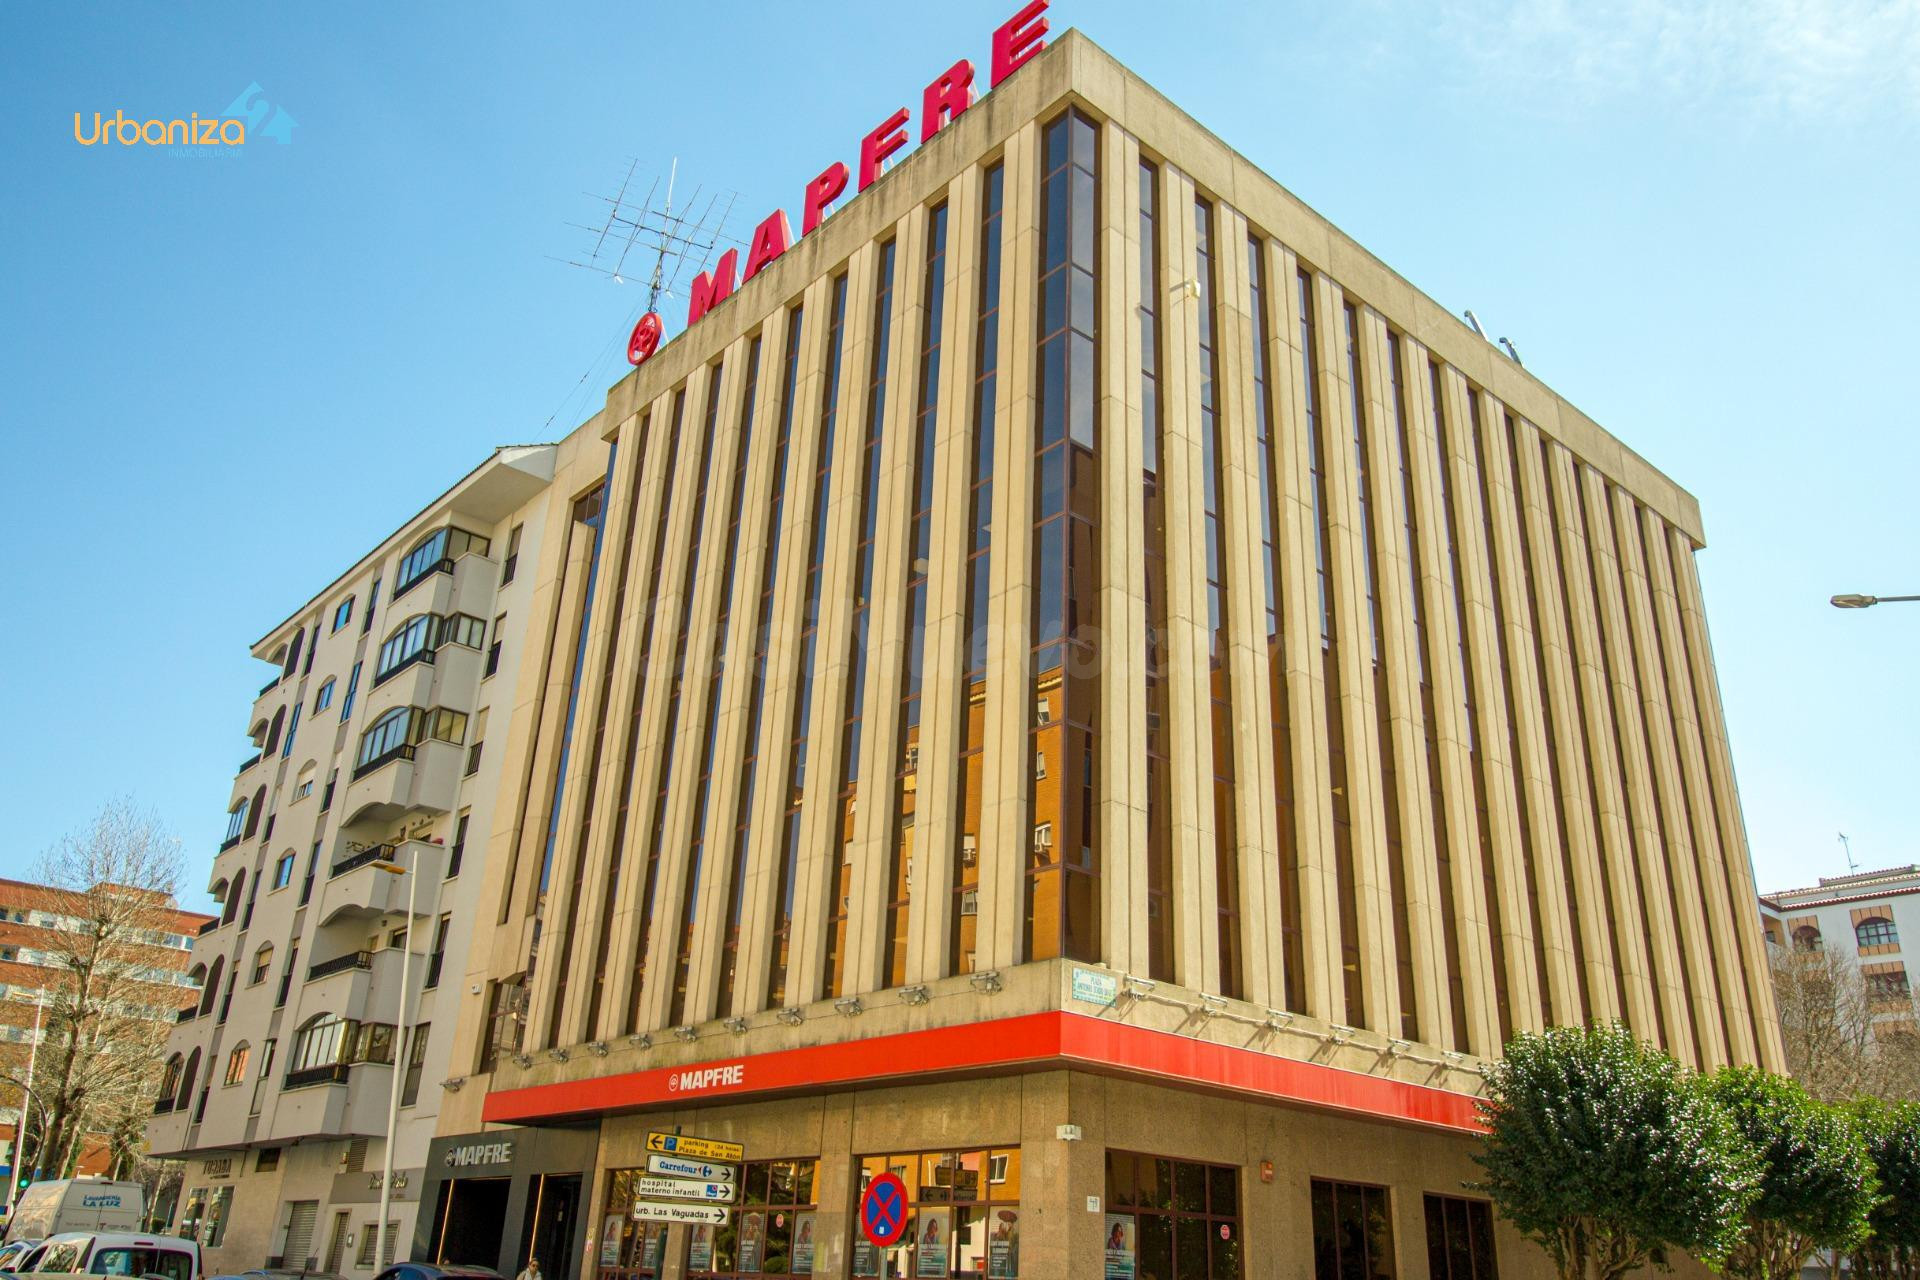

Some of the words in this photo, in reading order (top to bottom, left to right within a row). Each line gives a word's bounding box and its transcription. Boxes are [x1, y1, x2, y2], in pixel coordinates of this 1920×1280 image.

[687, 0, 1049, 328] MAPFRE
[680, 1064, 744, 1091] MAPFRE
[684, 1139, 709, 1149] parking
[454, 1142, 512, 1167] MAPFRE
[678, 1145, 697, 1155] Plaza
[711, 1150, 723, 1158] San
[659, 1160, 697, 1174] Carrefour
[641, 1179, 676, 1188] hospital
[672, 1188, 700, 1197] infantil
[636, 1206, 650, 1214] urb.
[654, 1208, 668, 1216] Las
[672, 1208, 709, 1219] Vaguadas
